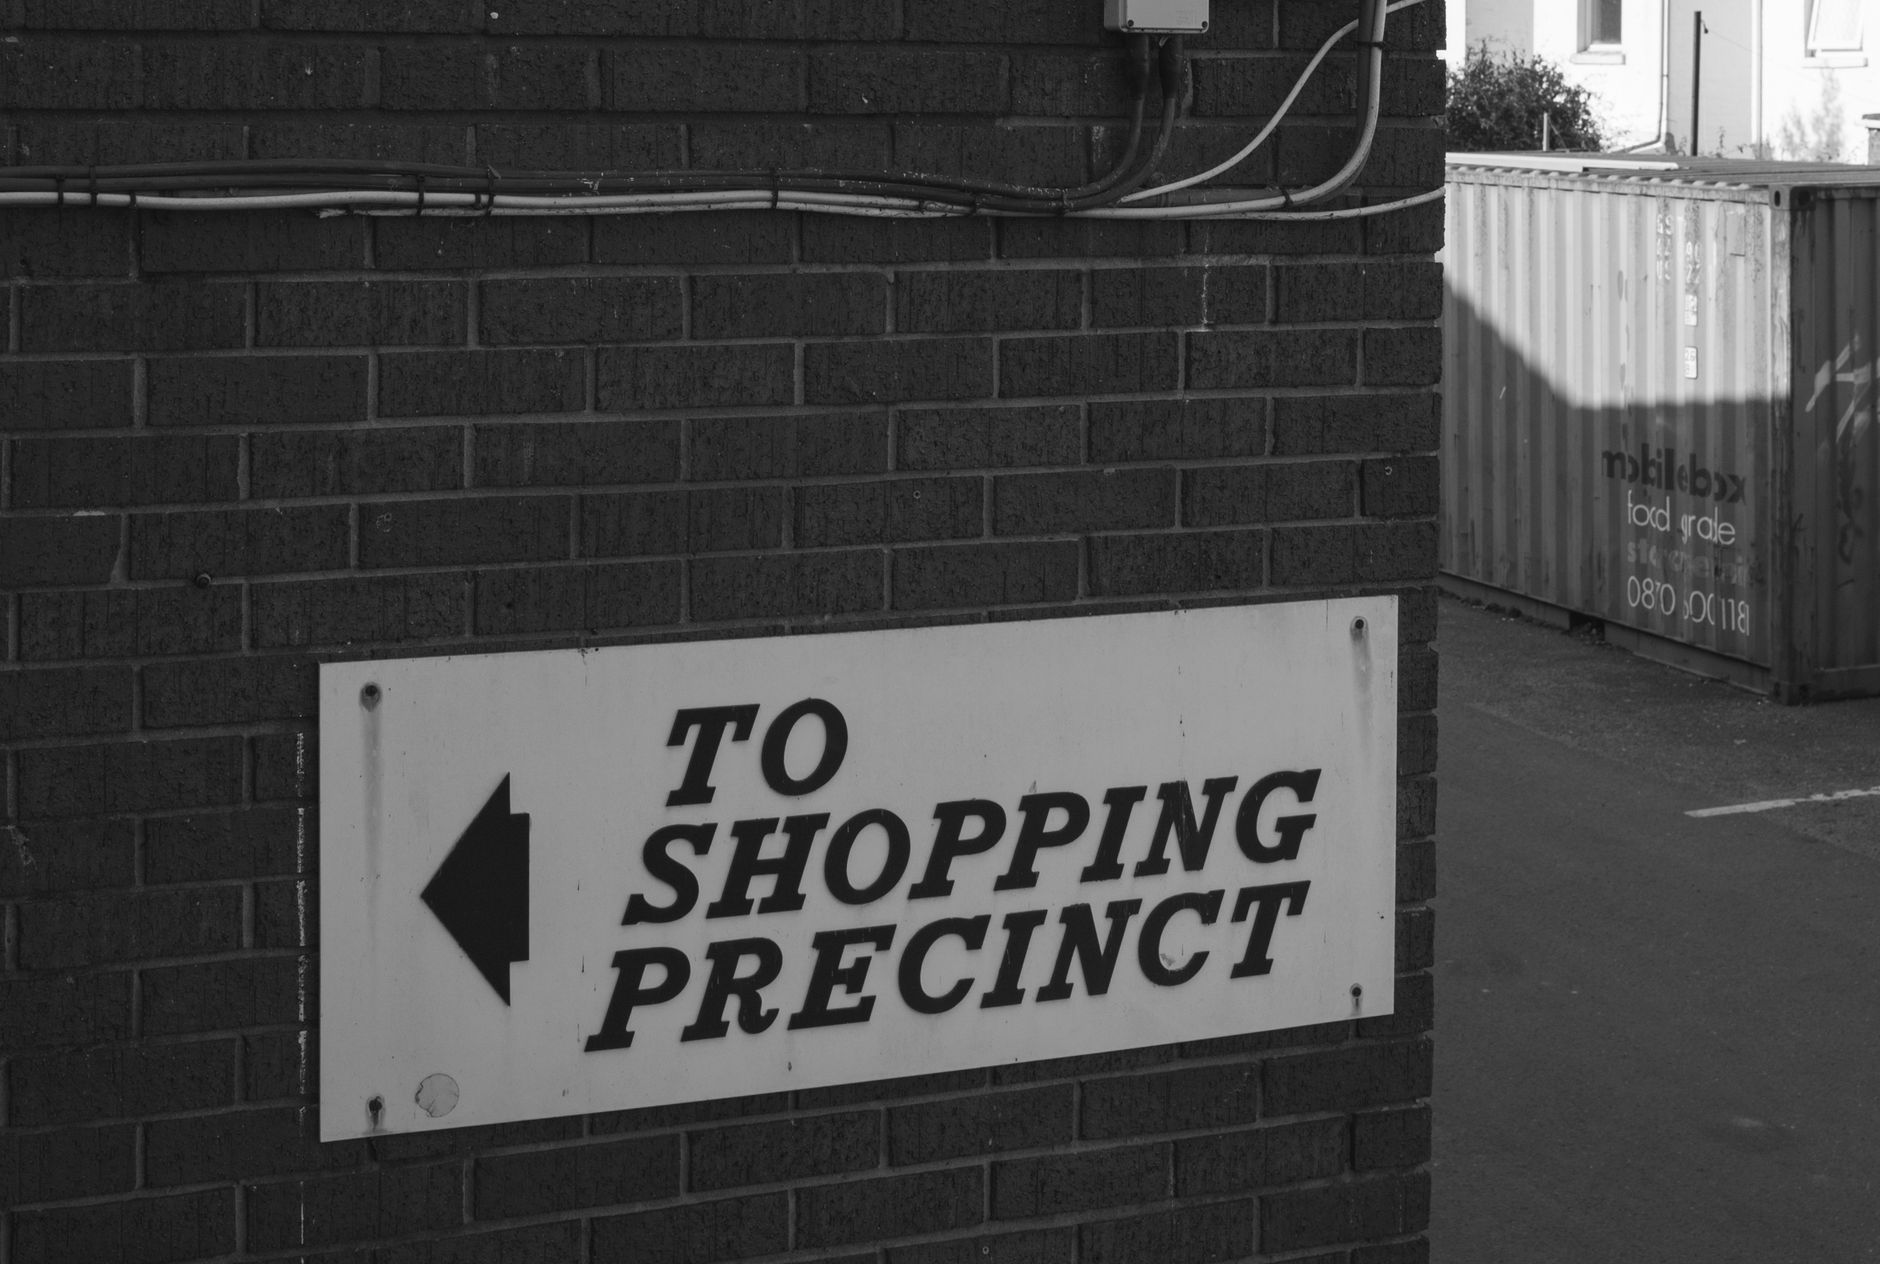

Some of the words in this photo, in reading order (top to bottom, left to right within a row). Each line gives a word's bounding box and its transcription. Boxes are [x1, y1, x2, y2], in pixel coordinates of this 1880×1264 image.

[1626, 489, 1671, 533] food
[665, 697, 849, 808] TO
[620, 768, 1322, 927] SHOPPING
[583, 879, 1312, 1053] PRECINCT
